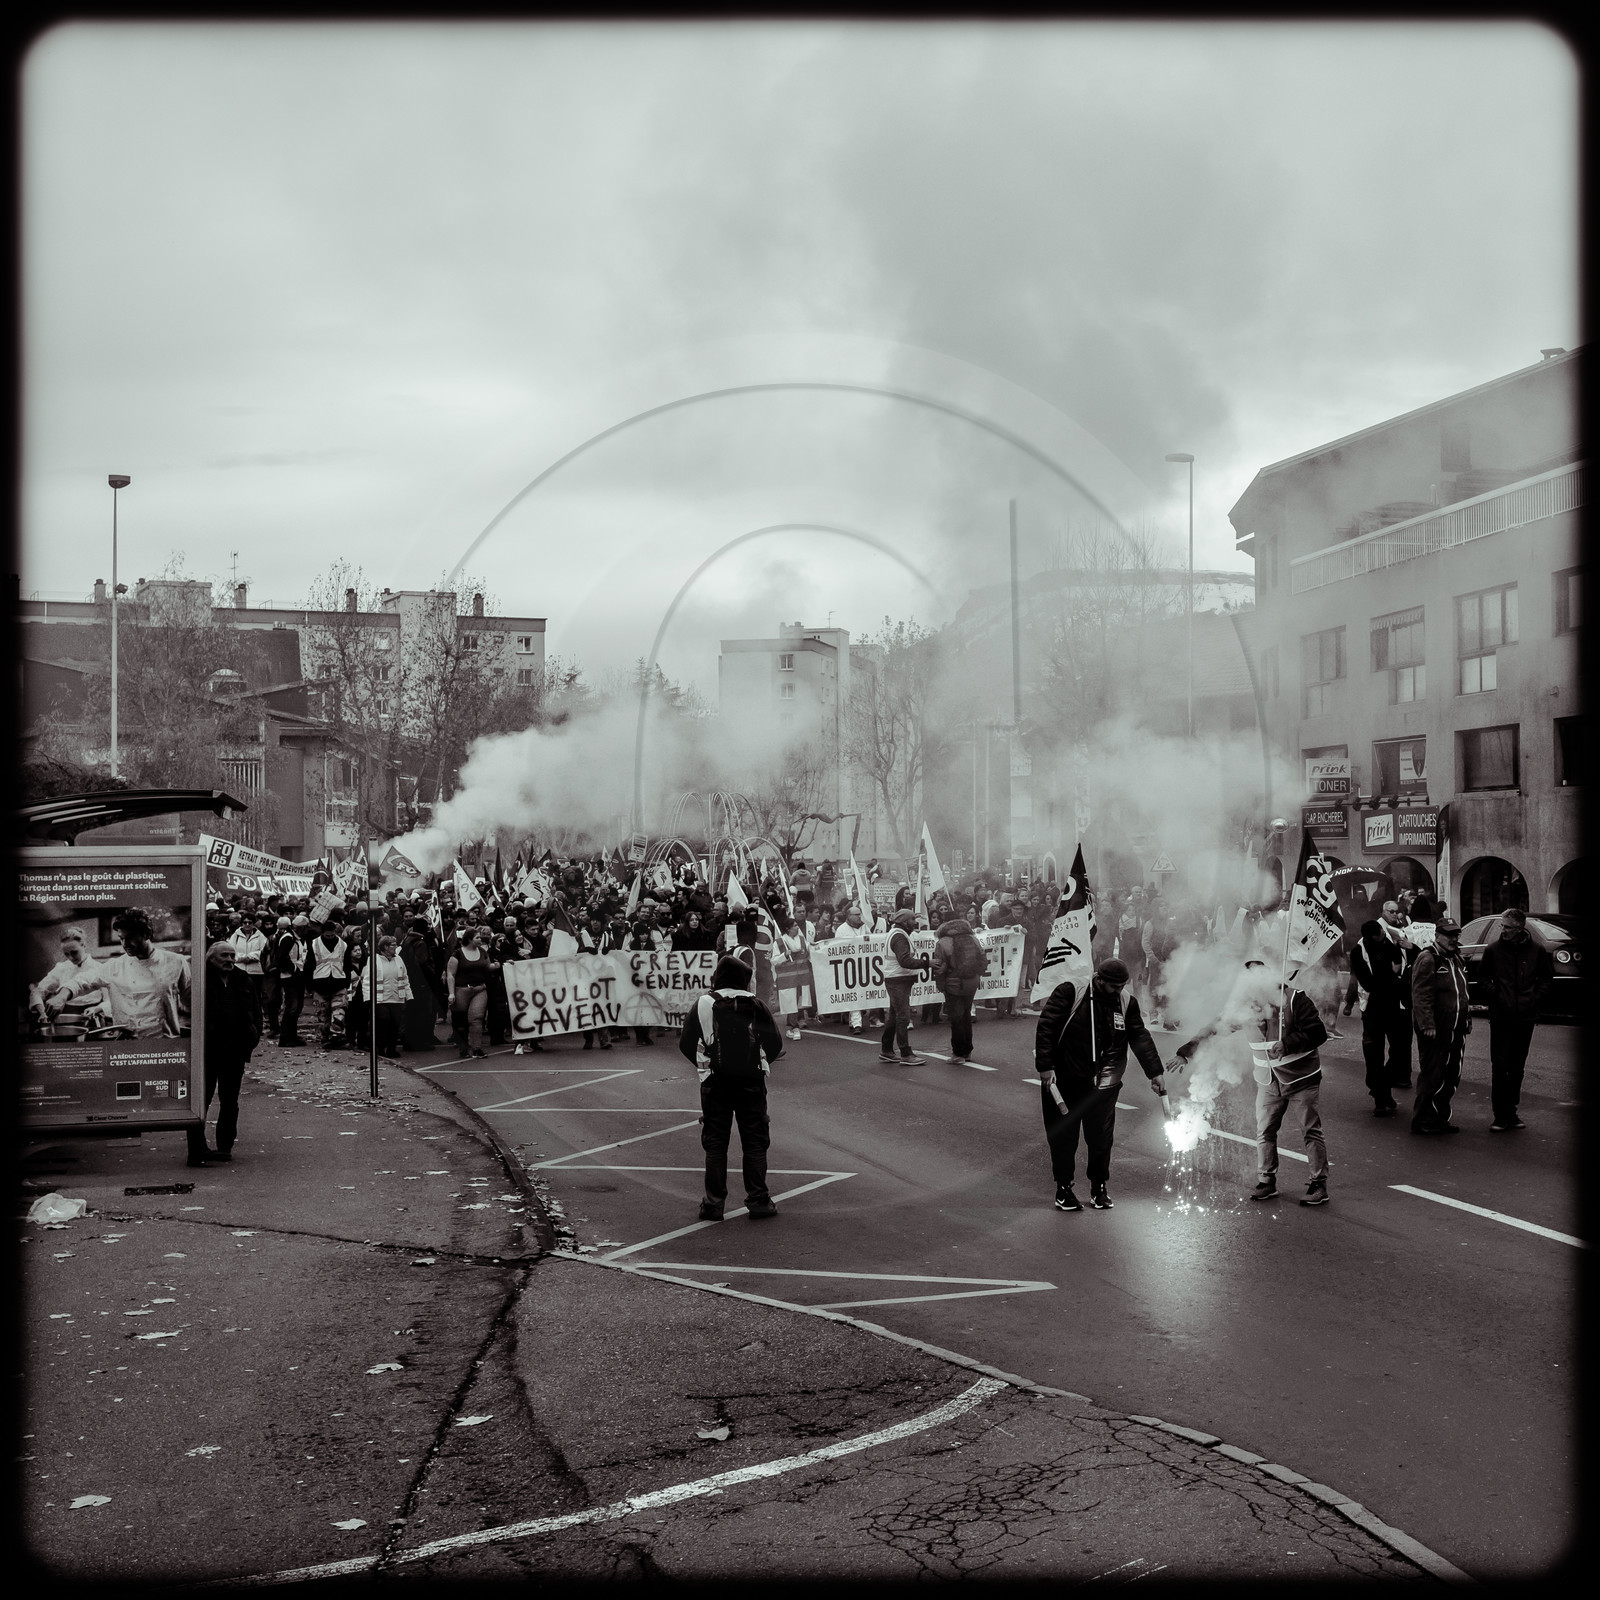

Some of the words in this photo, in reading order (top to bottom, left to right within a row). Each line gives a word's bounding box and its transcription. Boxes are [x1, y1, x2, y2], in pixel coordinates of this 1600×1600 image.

[1311, 762, 1347, 776] prink
[1313, 780, 1347, 792] TONER
[1398, 813, 1437, 828] CARTOUCHES
[1366, 820, 1392, 843] prink
[1398, 832, 1437, 846] IMPRIMANTES
[212, 839, 235, 857] FO
[210, 853, 228, 866] 05
[238, 850, 259, 864] RETRAIT
[259, 856, 278, 869] PROJET
[18, 873, 53, 882] Thomas
[67, 874, 82, 883] pas
[83, 872, 91, 881] le
[92, 871, 112, 882] goût
[113, 871, 125, 880] du
[125, 871, 167, 882] plastique.
[227, 871, 257, 891] FO
[18, 883, 52, 892] Surtout
[52, 882, 73, 891] dans
[73, 883, 89, 891] son
[89, 882, 134, 891] restaurant
[134, 881, 169, 890] scolaire.
[29, 893, 60, 903] Région
[61, 893, 77, 902] Sud
[96, 892, 116, 902] plus.
[827, 943, 856, 957] SALARIÉS
[858, 942, 880, 955] PUBLIC
[829, 955, 885, 990] TOUS
[511, 977, 616, 1012] BOULOT
[830, 993, 858, 1005] SALAIRES
[987, 979, 1010, 990] SOCIALE
[512, 1003, 621, 1035] CAVEAU
[117, 1052, 150, 1060] RÉDUCTION
